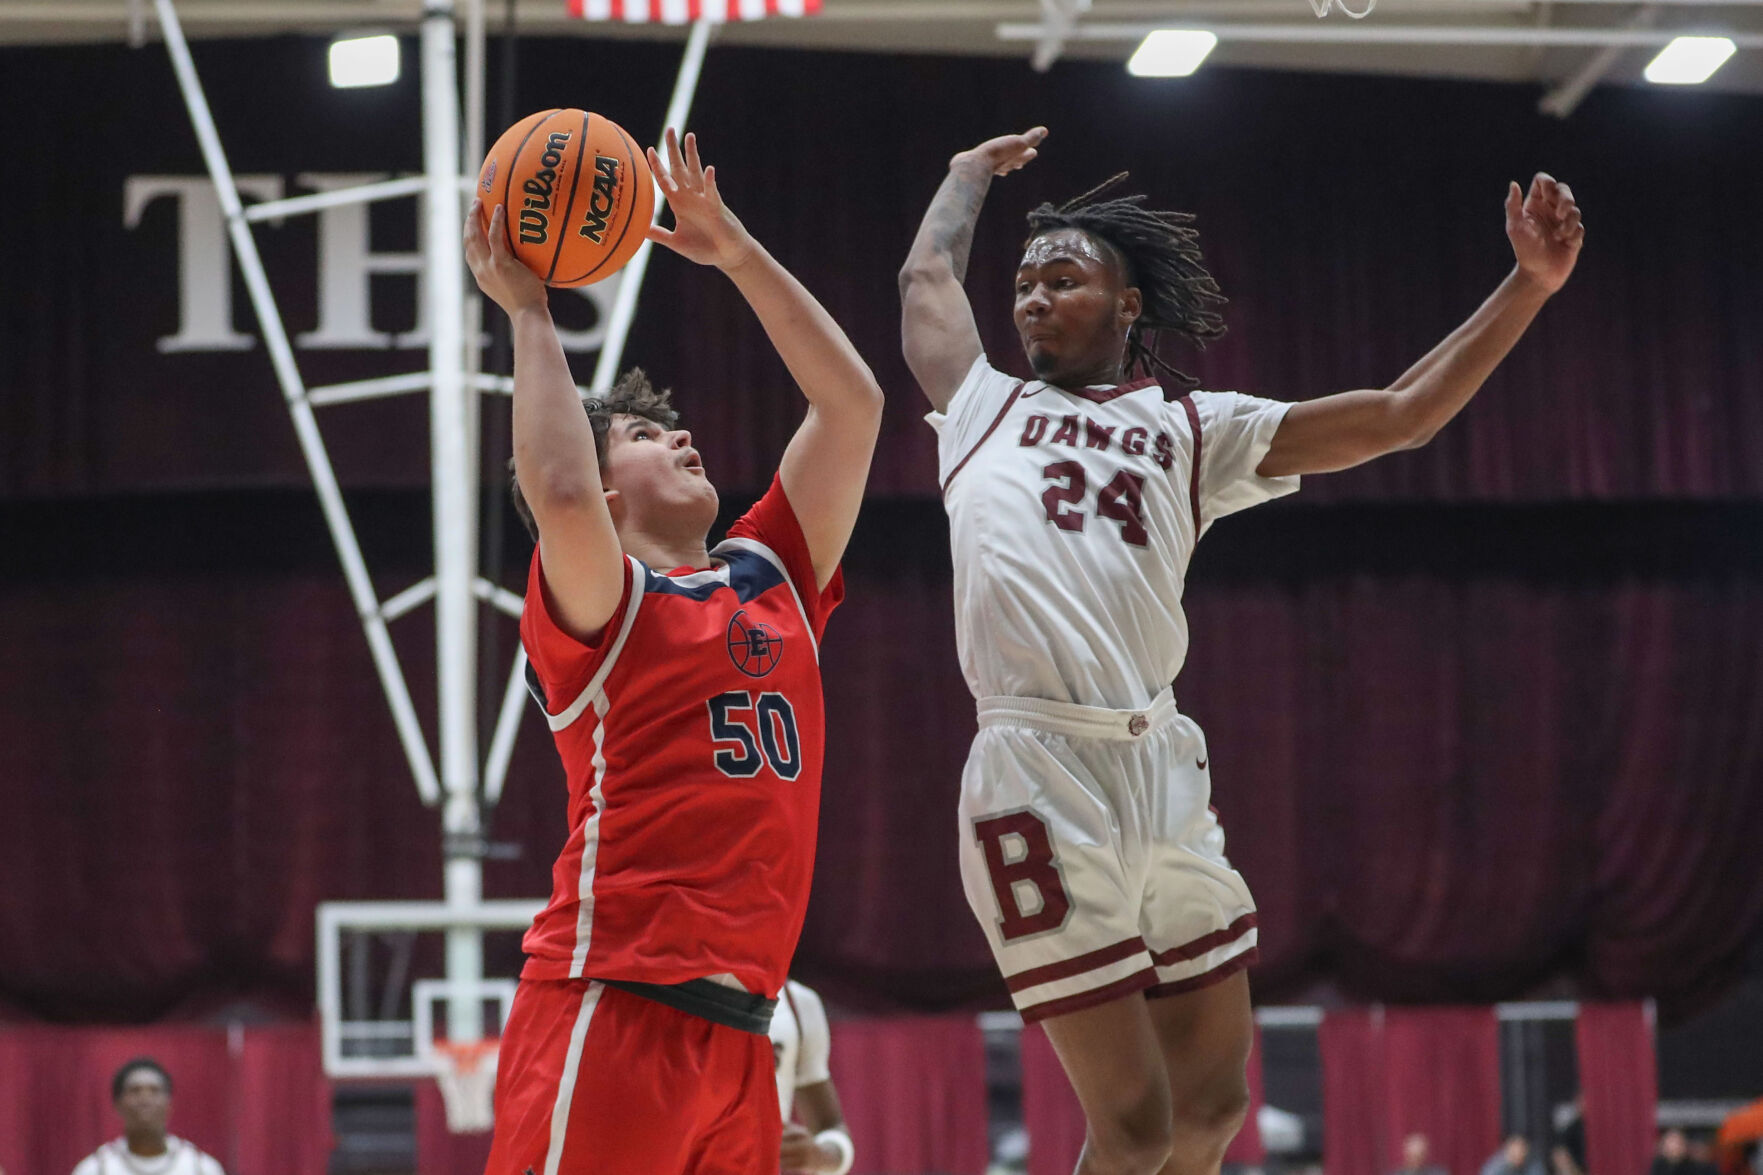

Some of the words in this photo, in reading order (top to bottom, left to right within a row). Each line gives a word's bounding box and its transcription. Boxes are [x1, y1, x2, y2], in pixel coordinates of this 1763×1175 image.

[519, 130, 571, 245] Wilson
[578, 155, 619, 244] NCAA
[1017, 413, 1174, 471] DAWGS
[1040, 459, 1149, 549] 24
[747, 627, 769, 657] E
[706, 690, 802, 782] 50
[970, 804, 1077, 947] B
